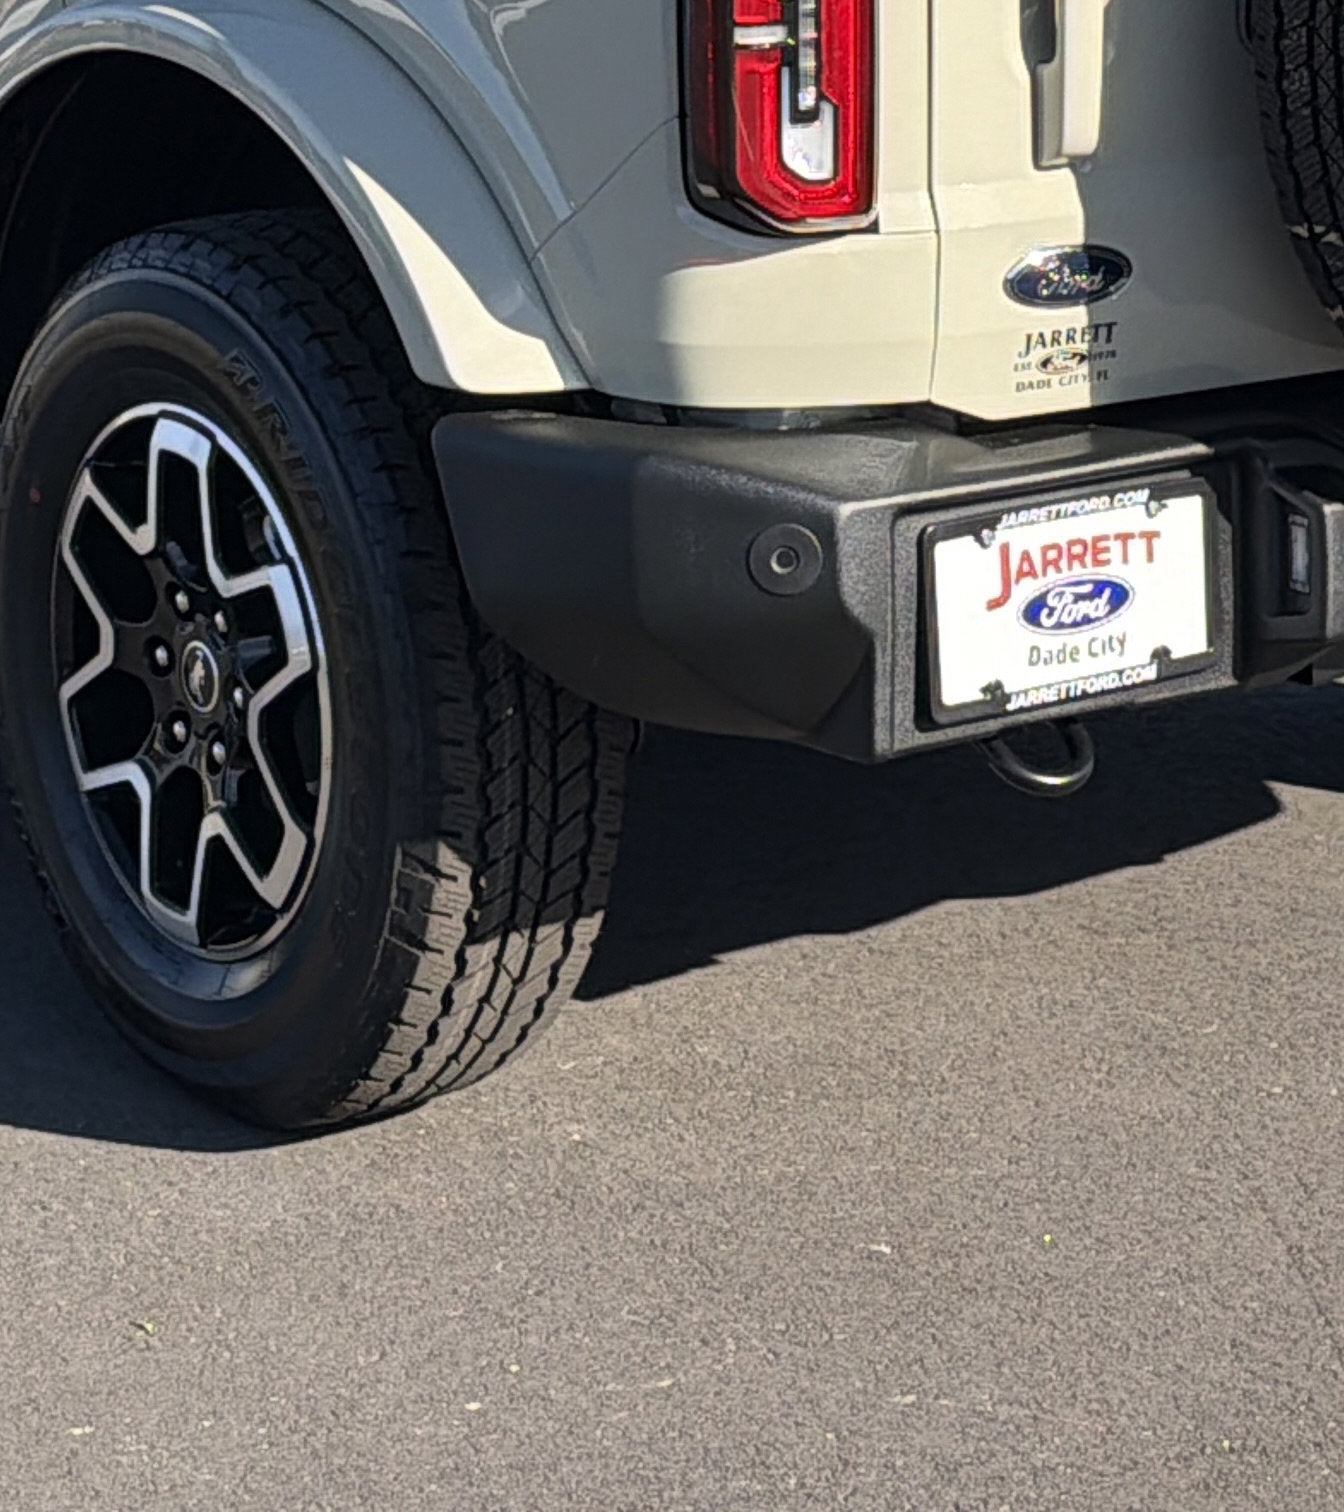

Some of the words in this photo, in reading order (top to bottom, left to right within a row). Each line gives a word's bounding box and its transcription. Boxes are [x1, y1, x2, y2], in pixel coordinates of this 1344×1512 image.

[1017, 321, 1118, 358] JARRETT
[987, 531, 1160, 610] JARRETT
[1040, 584, 1111, 627] Ford
[1028, 642, 1081, 667] Dade
[1087, 632, 1128, 658] City
[1006, 663, 1158, 711] JARRETTFORD.COM
